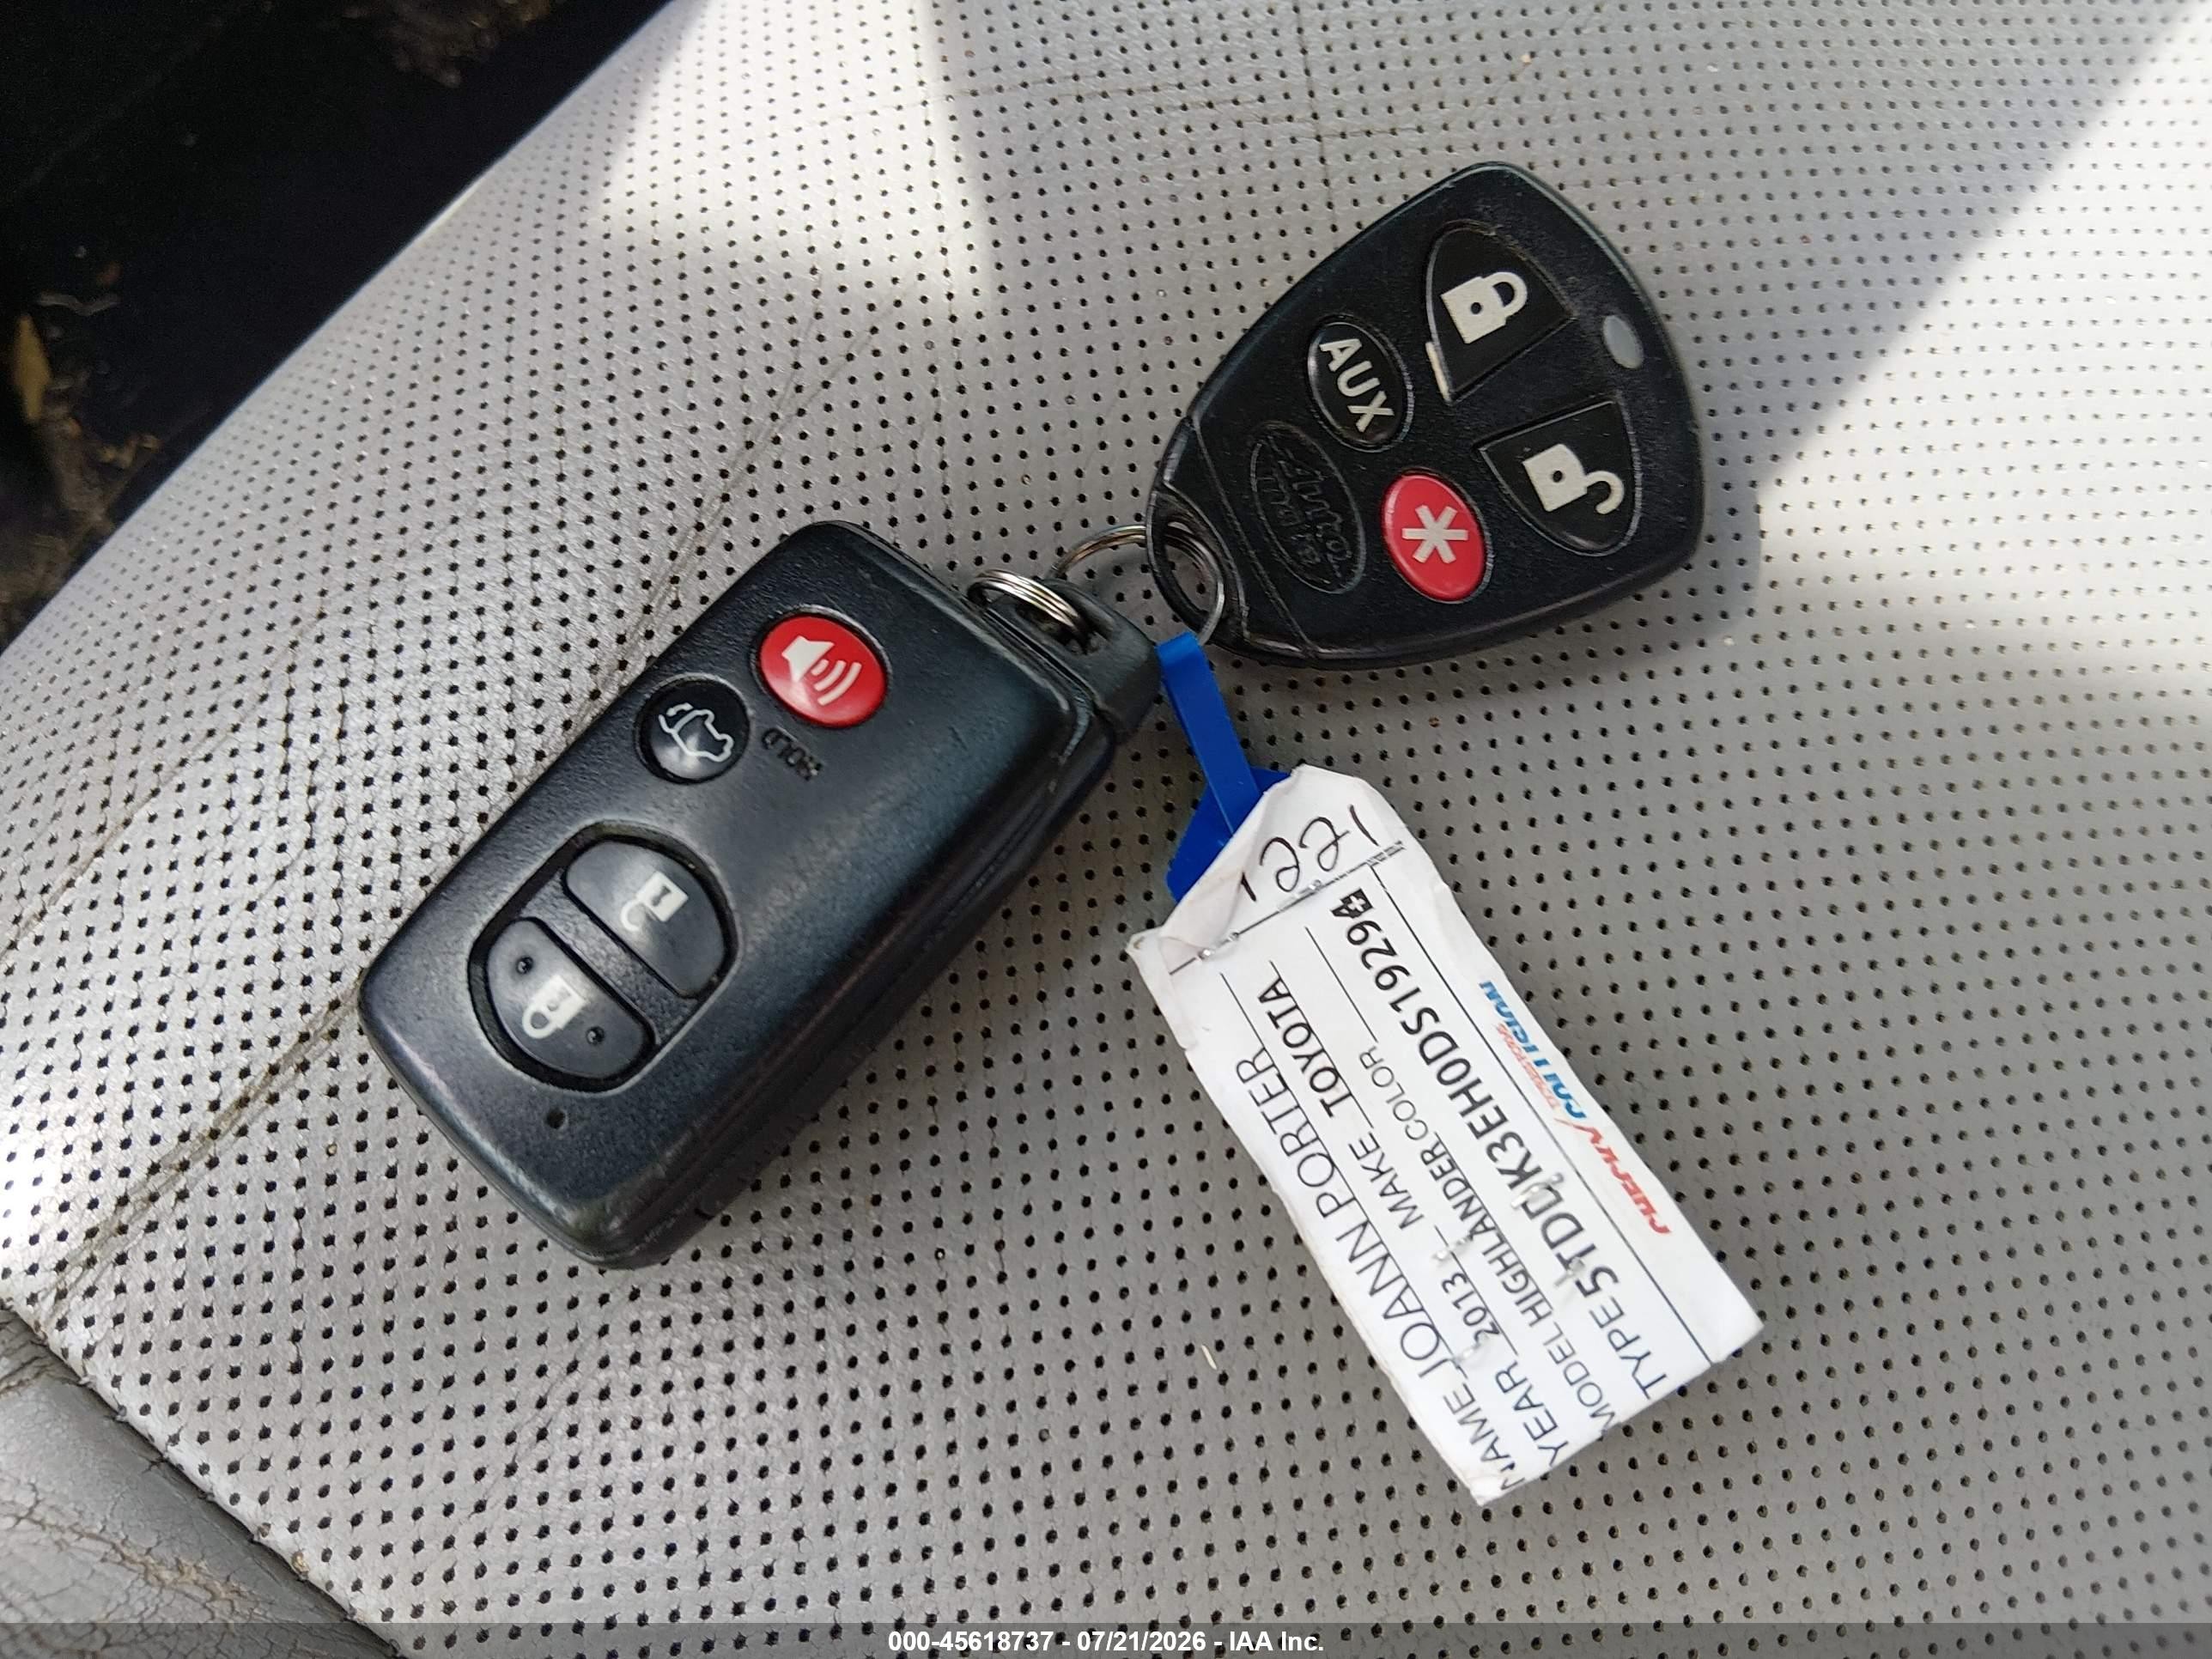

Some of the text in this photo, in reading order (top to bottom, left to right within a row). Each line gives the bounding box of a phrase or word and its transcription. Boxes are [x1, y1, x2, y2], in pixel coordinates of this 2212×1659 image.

[1319, 338, 1395, 433] AUX
[1359, 1046, 1429, 1141] COLOR
[1236, 1045, 1527, 1492] NAME JOANN PORTER
[1257, 975, 1578, 1469] YEAR 2013 MAKE TOYOTA
[1420, 1138, 1553, 1327] HIGHLANDER
[1544, 1322, 1624, 1436] MODEL
[1589, 1297, 1668, 1401] TYPE
